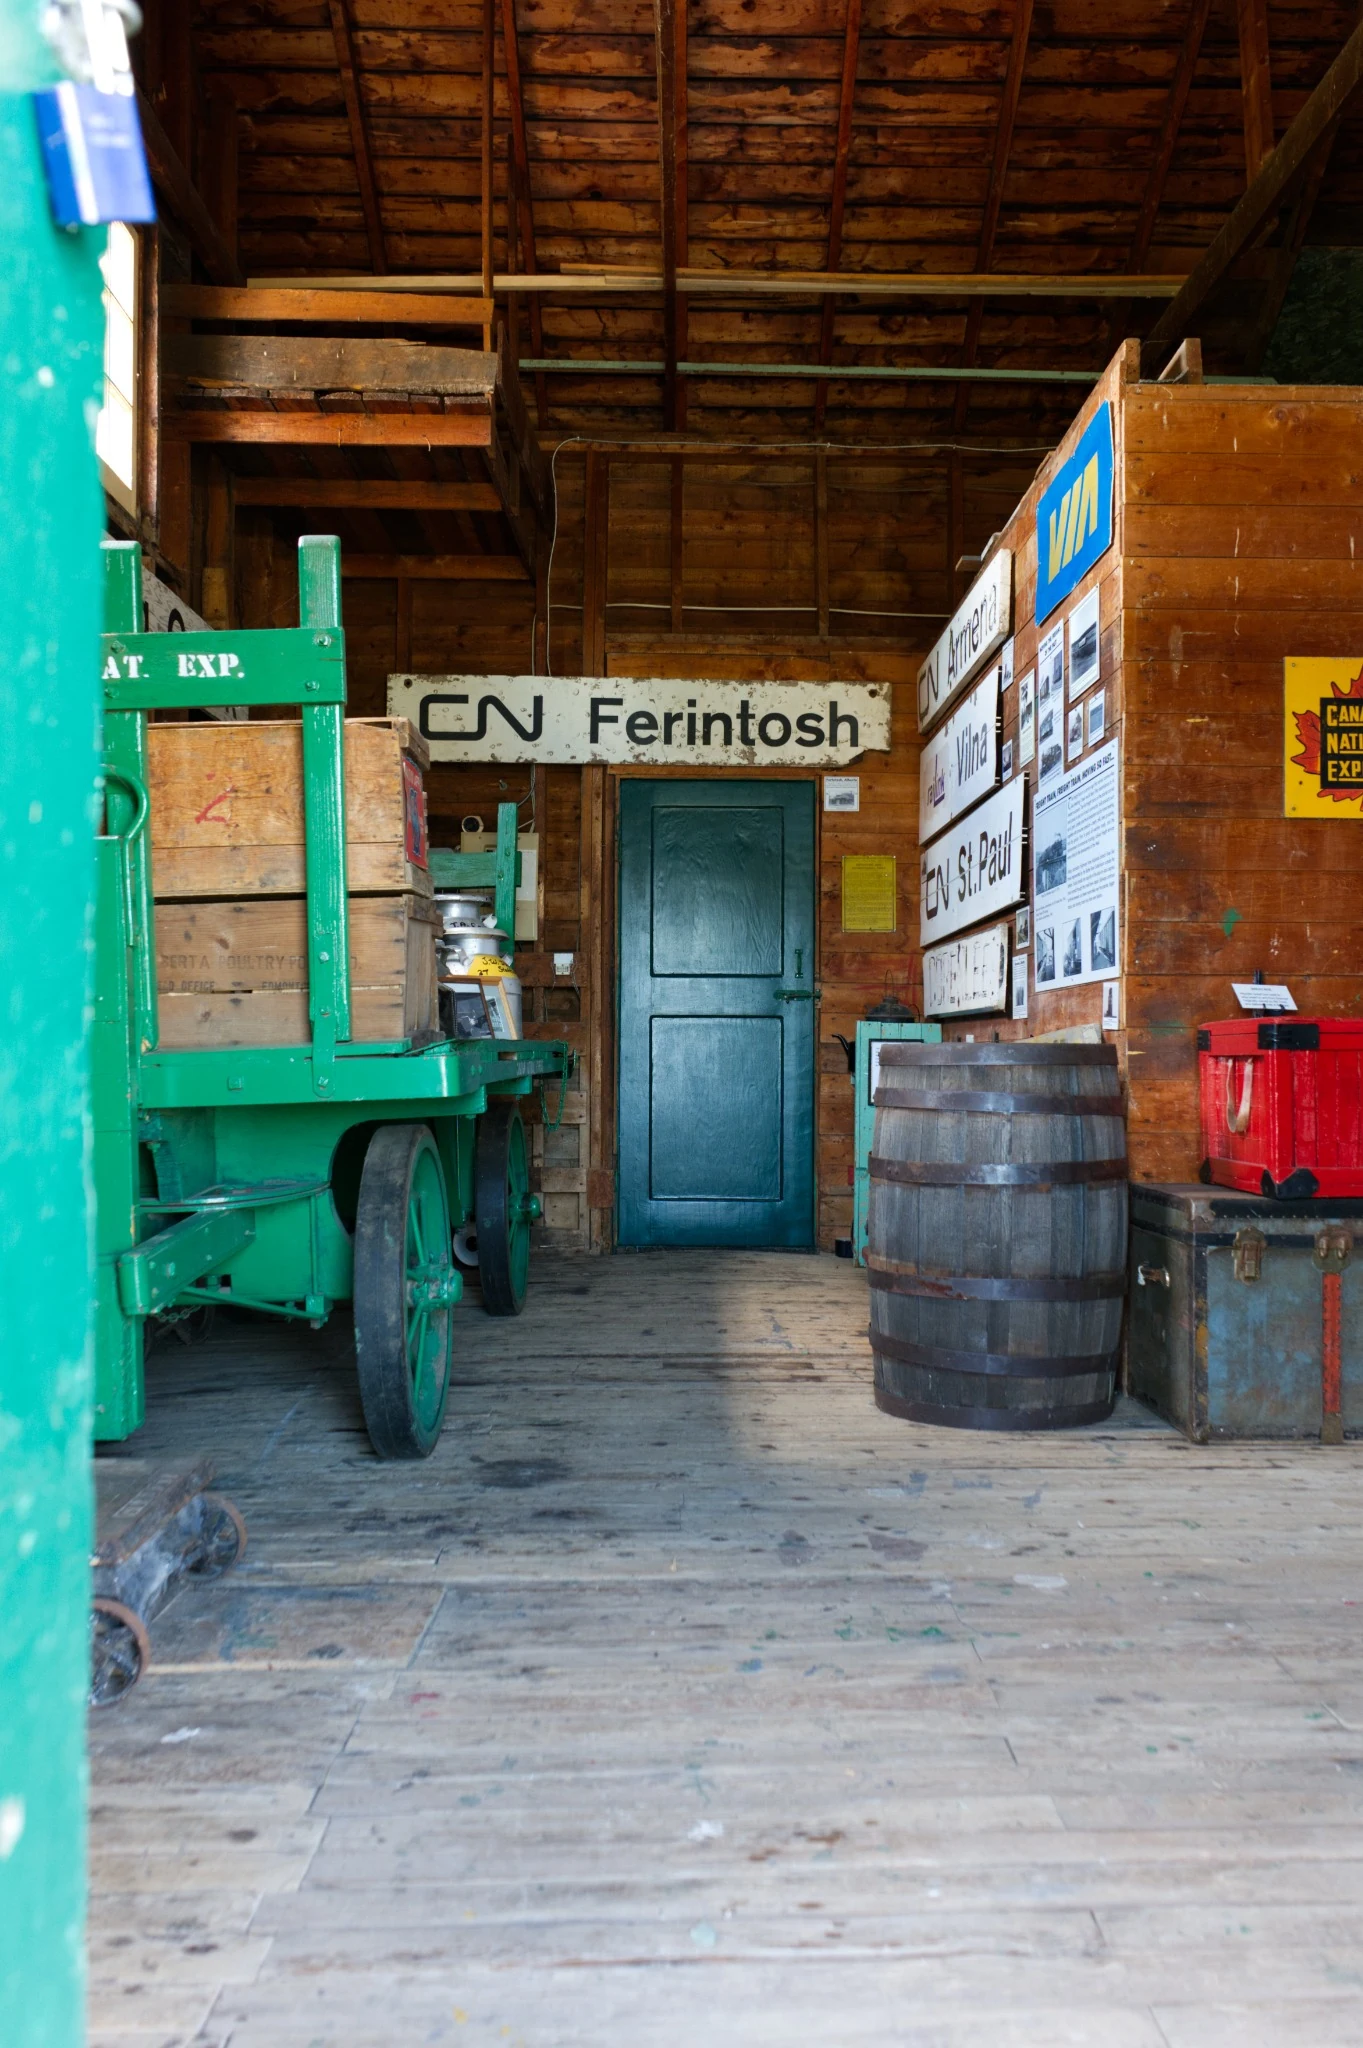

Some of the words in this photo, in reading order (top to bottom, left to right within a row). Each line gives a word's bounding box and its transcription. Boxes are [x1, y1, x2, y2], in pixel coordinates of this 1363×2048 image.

[1048, 452, 1098, 585] VIA
[178, 653, 245, 678] EXP.
[948, 584, 997, 688] Armena
[419, 694, 544, 741] CN
[589, 697, 860, 748] Ferintosh
[956, 721, 988, 786] Vilna
